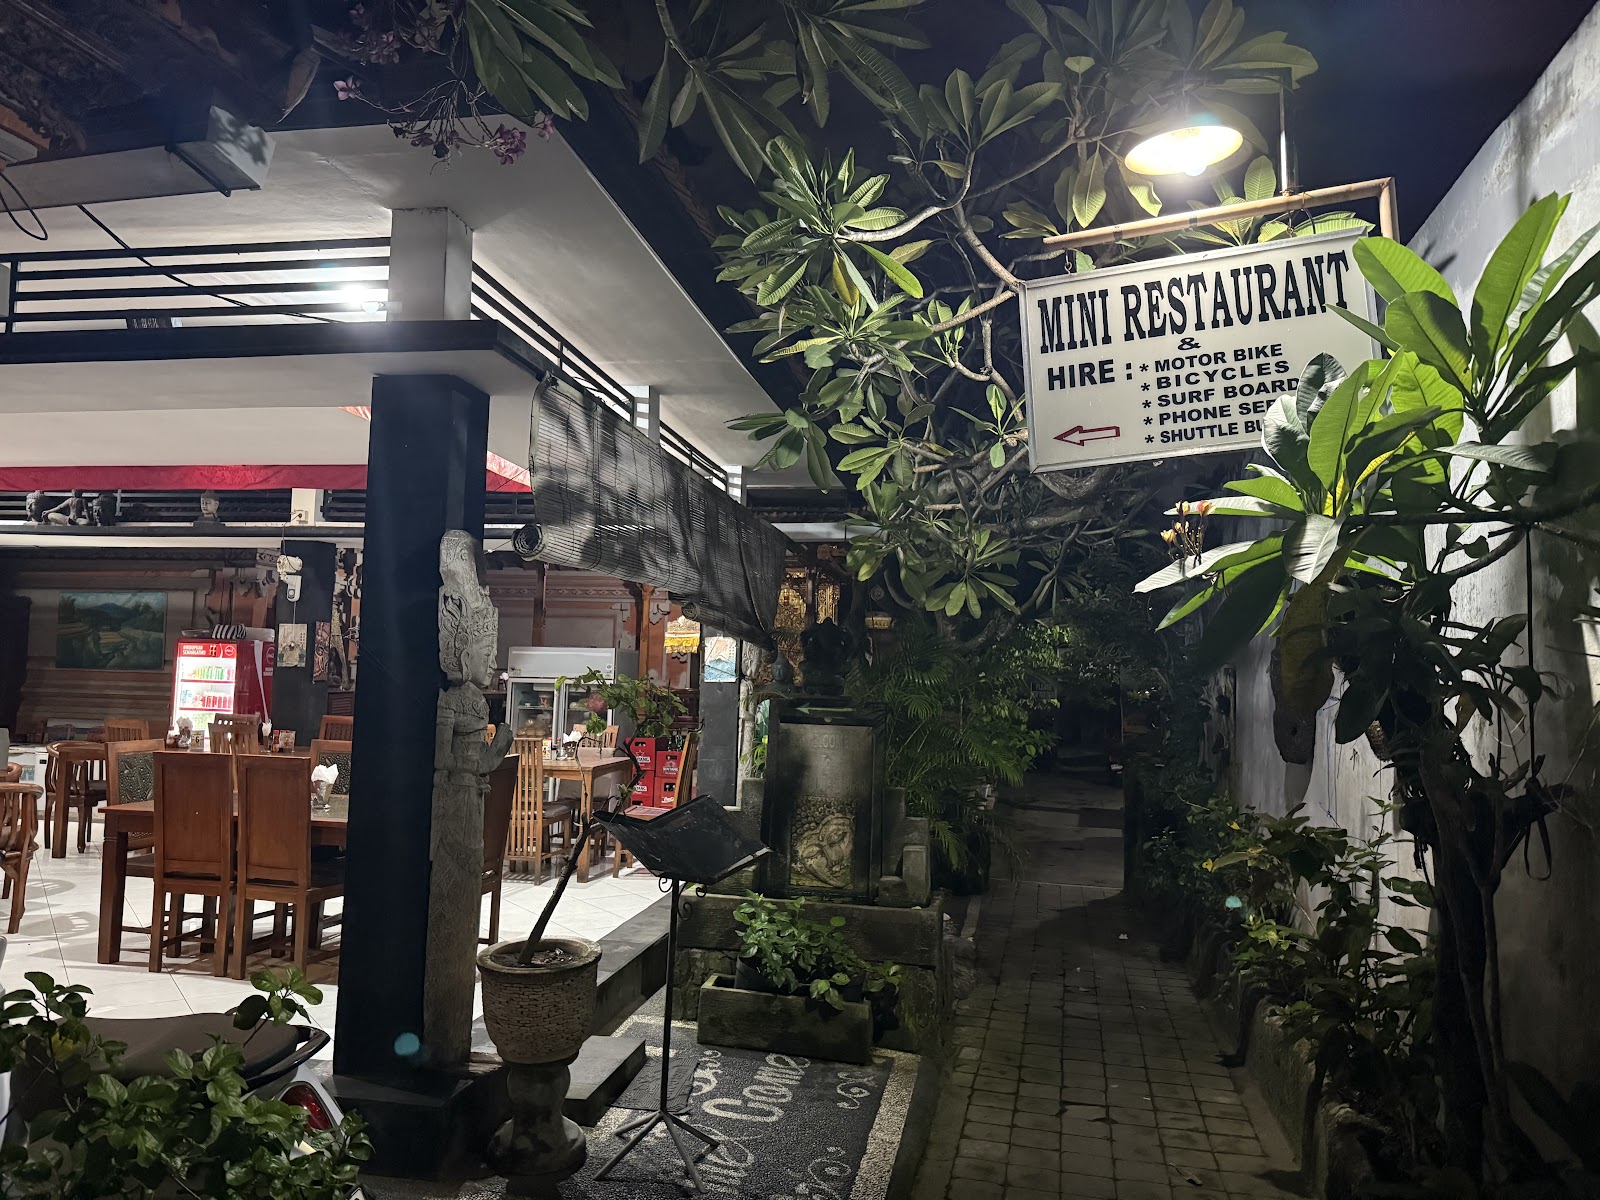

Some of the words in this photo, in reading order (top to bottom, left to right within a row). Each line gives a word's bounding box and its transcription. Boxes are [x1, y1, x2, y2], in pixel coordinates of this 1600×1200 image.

[1038, 288, 1112, 355] MINI
[1120, 249, 1350, 342] RESTAURANT
[1154, 351, 1228, 373] MOTOR
[1233, 343, 1284, 362] BIKE
[1177, 337, 1202, 351] &
[1047, 358, 1116, 392] HIRE
[1156, 360, 1290, 390] BICYCLES
[1157, 387, 1216, 408] SURF
[1223, 377, 1300, 400] BOARD
[1158, 404, 1232, 426] PHONE
[1160, 421, 1239, 444] SHUTTLE
